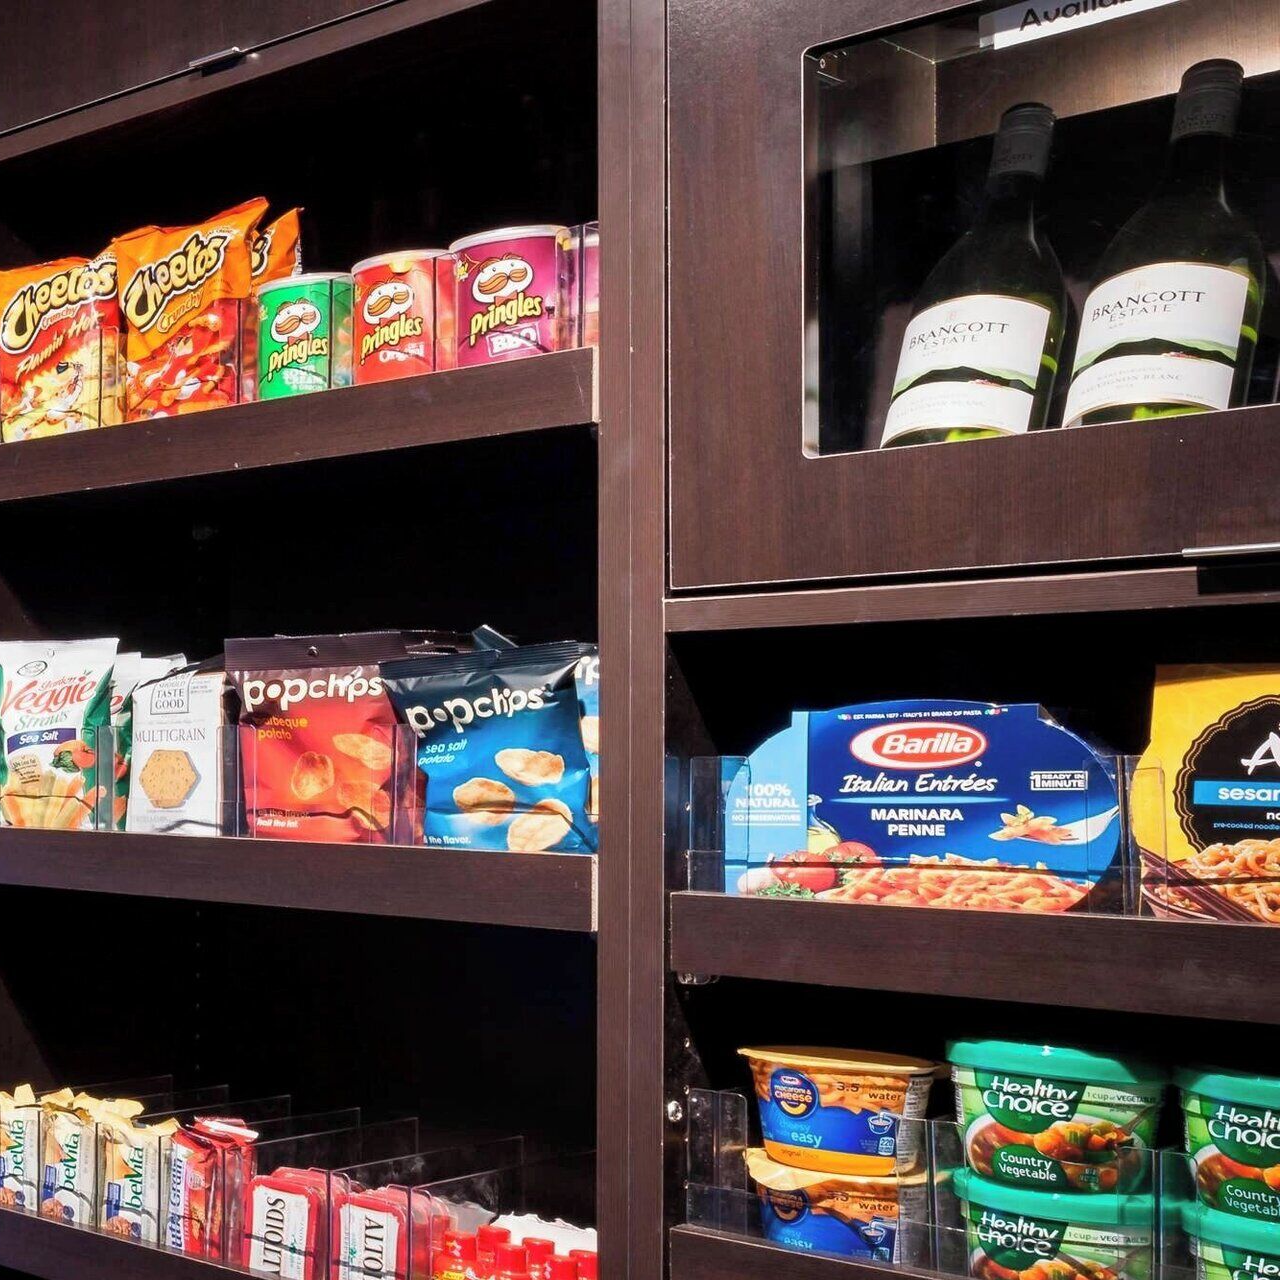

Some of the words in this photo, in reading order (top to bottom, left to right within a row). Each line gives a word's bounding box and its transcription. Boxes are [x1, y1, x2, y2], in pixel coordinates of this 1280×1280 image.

[125, 228, 227, 328] Cheetos
[1, 260, 117, 352] Cheetos
[156, 288, 205, 334] Crunchy
[1092, 290, 1206, 322] BRANCOTT
[1108, 304, 1171, 322] ESTATE
[40, 304, 80, 331] Crunchy
[471, 296, 542, 346] Pringles
[361, 314, 424, 364] Pringles
[493, 327, 536, 353] BBQ
[909, 321, 1009, 350] BRANCOTT
[923, 334, 978, 350] ESTATE
[16, 335, 65, 381] Flamin'
[66, 311, 105, 340] Hot
[269, 336, 328, 381] Pringles
[1, 676, 96, 717] Veggie
[157, 689, 184, 697] TASTE
[243, 674, 383, 712] popchips
[155, 699, 184, 709] GOOD
[407, 687, 544, 738] popchips
[19, 734, 39, 744] Sea
[40, 731, 59, 741] Salt
[135, 728, 206, 743] MULTIGRAIN
[257, 728, 292, 741] potato
[883, 732, 973, 754] Barilla
[425, 743, 445, 754] sea
[448, 740, 467, 751] salt
[418, 754, 455, 766] potato
[745, 783, 792, 796] 100%
[839, 772, 908, 793] Italian
[915, 773, 998, 792] Entrées
[1041, 780, 1085, 788] MINUTE
[735, 798, 800, 808] NATURAL
[273, 819, 287, 828] the
[731, 814, 747, 822] NO
[871, 808, 963, 821] MARINARA
[888, 824, 945, 836] PENNE
[443, 835, 471, 845] flavor.
[836, 1081, 860, 1092] 3.5
[991, 1075, 1078, 1101] Healthy
[868, 1092, 902, 1101] water
[983, 1089, 1070, 1118] Choice
[1092, 1093, 1108, 1102] cup
[7, 1119, 25, 1178] belVita
[791, 1132, 822, 1147] easy
[880, 1138, 893, 1147] 220
[59, 1132, 80, 1192] belVita
[1000, 1151, 1053, 1170] Country
[124, 1147, 144, 1210] belVita
[999, 1163, 1057, 1181] Vegetable
[859, 1202, 895, 1211] water
[981, 1211, 1059, 1239] Healthy
[976, 1225, 1054, 1256] Choice
[1073, 1232, 1091, 1241] cup
